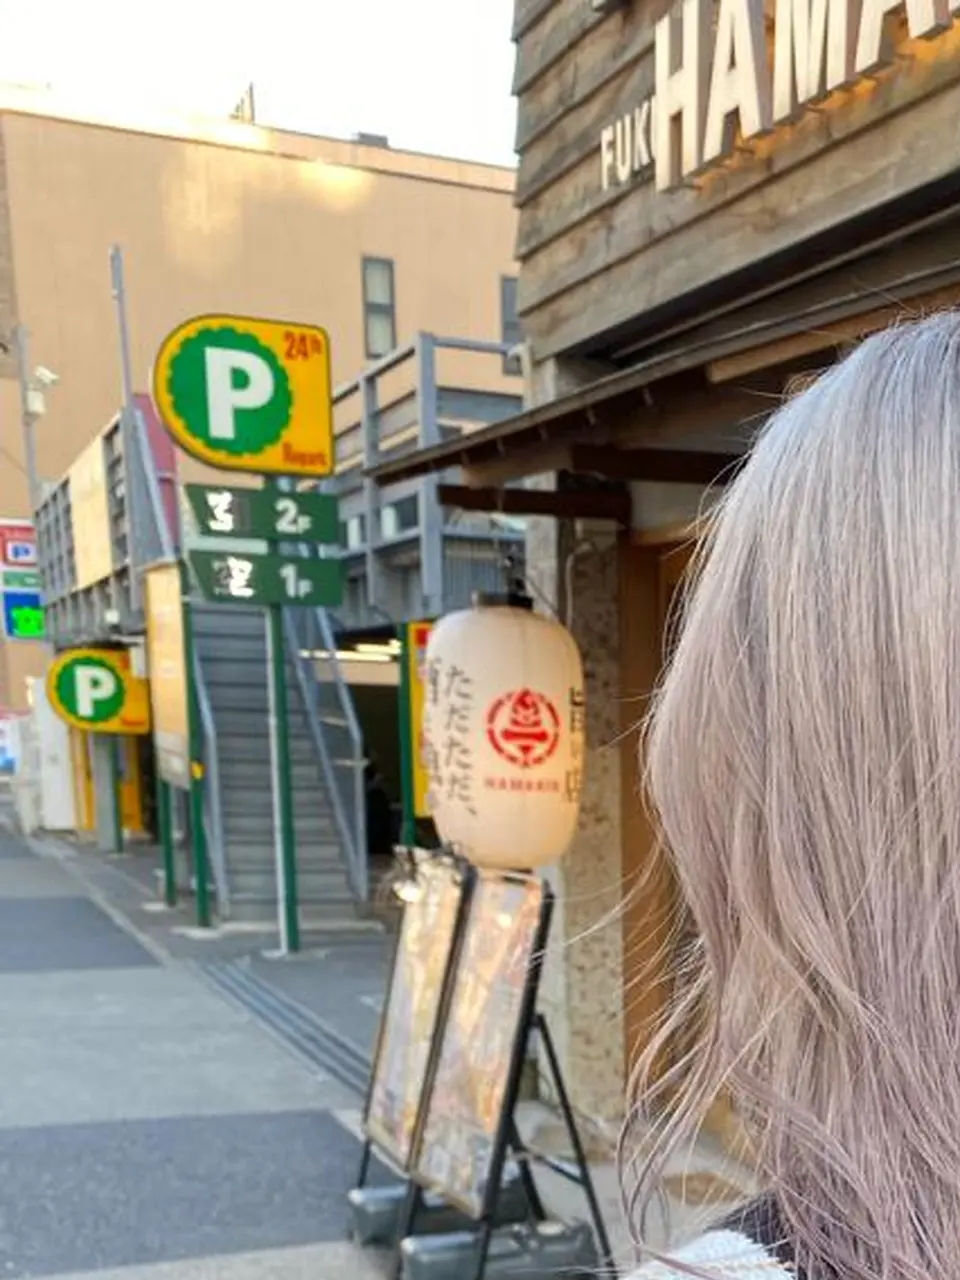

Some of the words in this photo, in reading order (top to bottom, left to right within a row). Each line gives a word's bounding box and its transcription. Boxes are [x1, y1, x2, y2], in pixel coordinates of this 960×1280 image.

[601, 96, 656, 191] FUK
[204, 345, 275, 440] P
[73, 664, 117, 717] P
